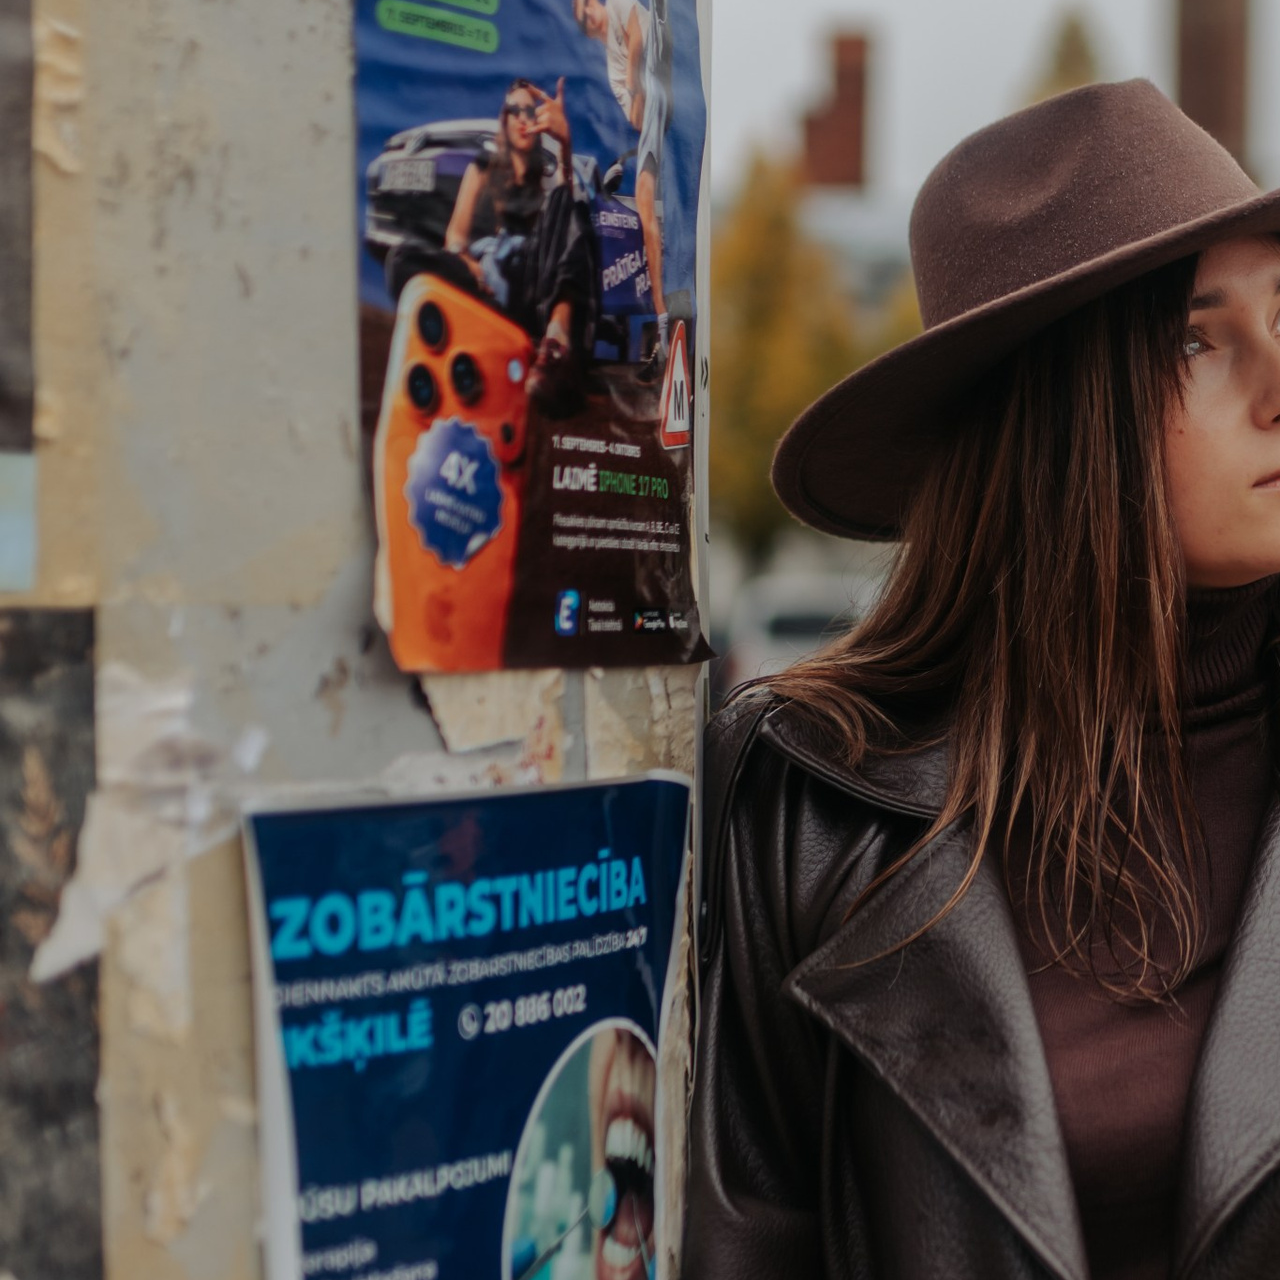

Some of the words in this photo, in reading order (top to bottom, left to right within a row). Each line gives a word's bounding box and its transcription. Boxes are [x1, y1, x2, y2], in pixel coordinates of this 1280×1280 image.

[672, 379, 685, 421] M
[440, 452, 479, 495] 4X
[599, 472, 636, 494] IPHONE
[638, 474, 650, 496] 17
[651, 477, 669, 500] PRO
[270, 850, 647, 960] ZOBĀRSTNIECĪBA
[485, 1002, 512, 1033] 20
[553, 986, 586, 1016] 002
[301, 1184, 357, 1221] ŪSU
[361, 1151, 511, 1210] PAKALPOJUMI
